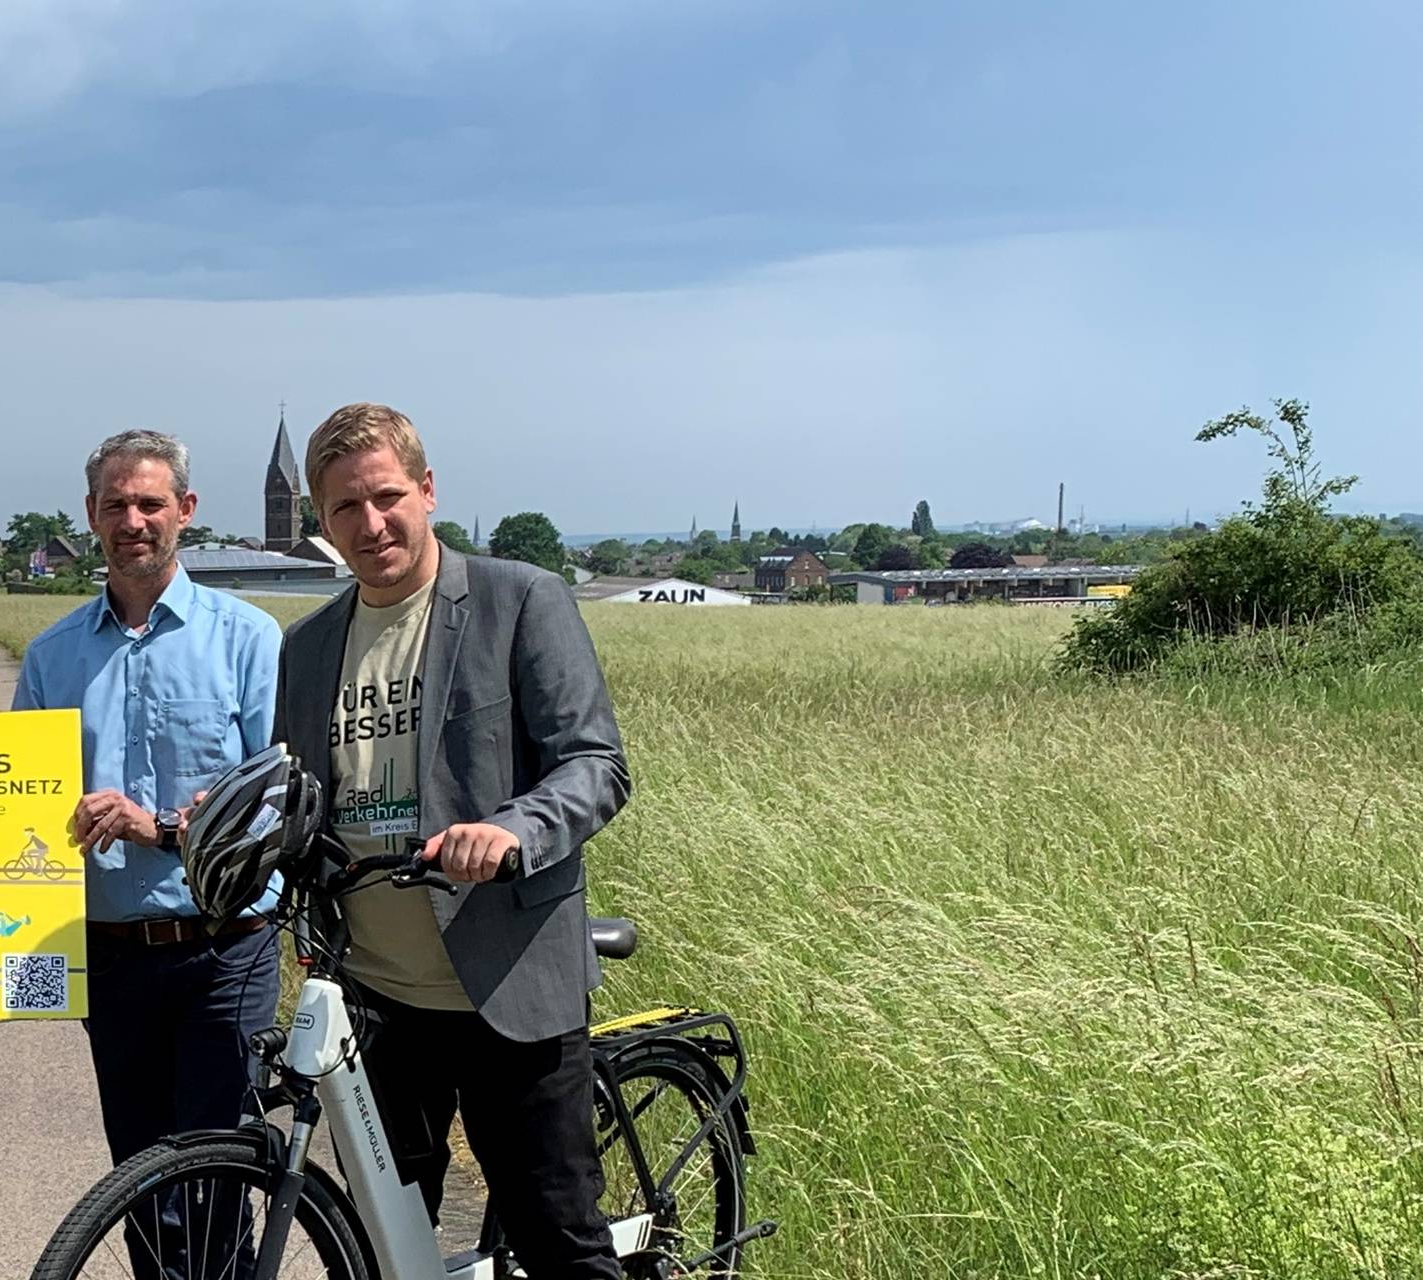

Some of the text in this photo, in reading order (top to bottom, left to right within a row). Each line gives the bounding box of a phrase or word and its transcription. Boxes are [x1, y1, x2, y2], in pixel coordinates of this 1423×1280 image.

[639, 589, 705, 604] ZAUN
[342, 682, 378, 713] ÜR
[346, 784, 384, 807] Rad
